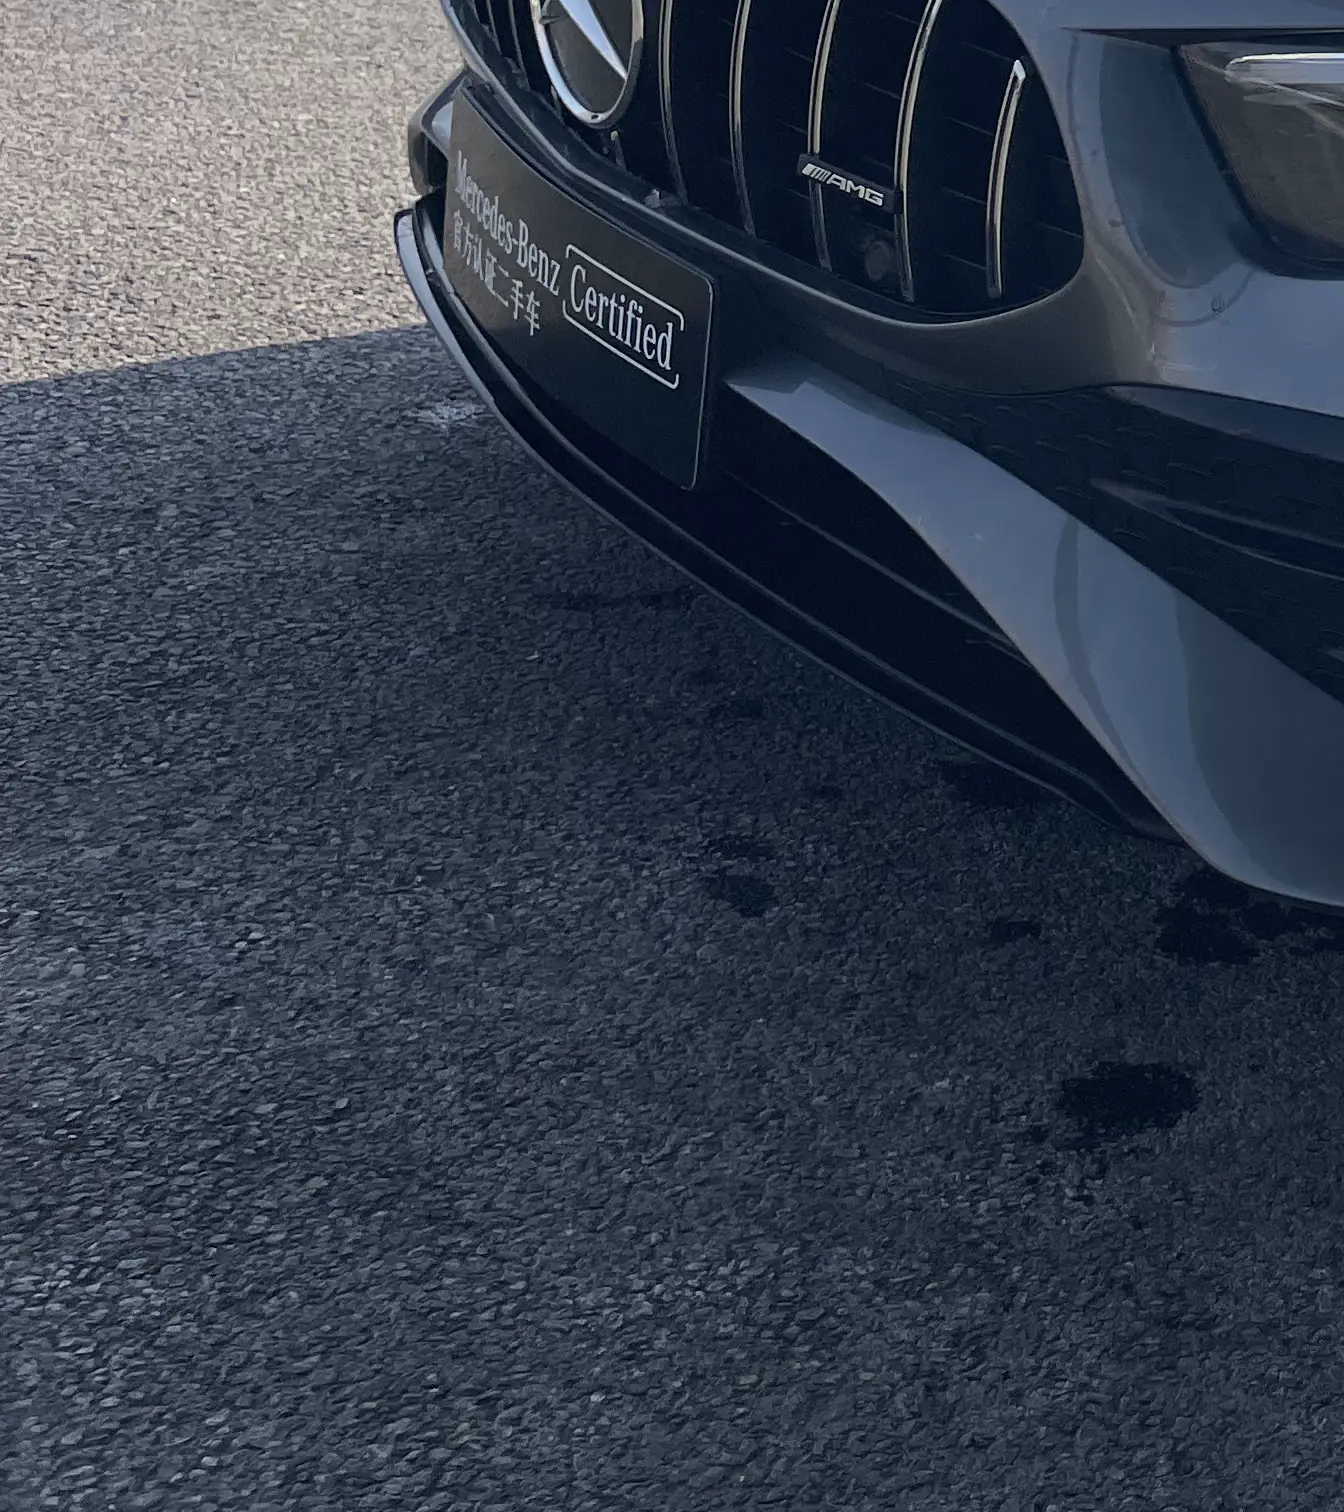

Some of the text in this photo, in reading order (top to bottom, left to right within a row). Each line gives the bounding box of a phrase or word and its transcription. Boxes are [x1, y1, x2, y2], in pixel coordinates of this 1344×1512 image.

[826, 173, 885, 207] AMG
[453, 208, 541, 336] 官方认证二手车
[454, 149, 673, 371] Mercedes-Benz Certified
